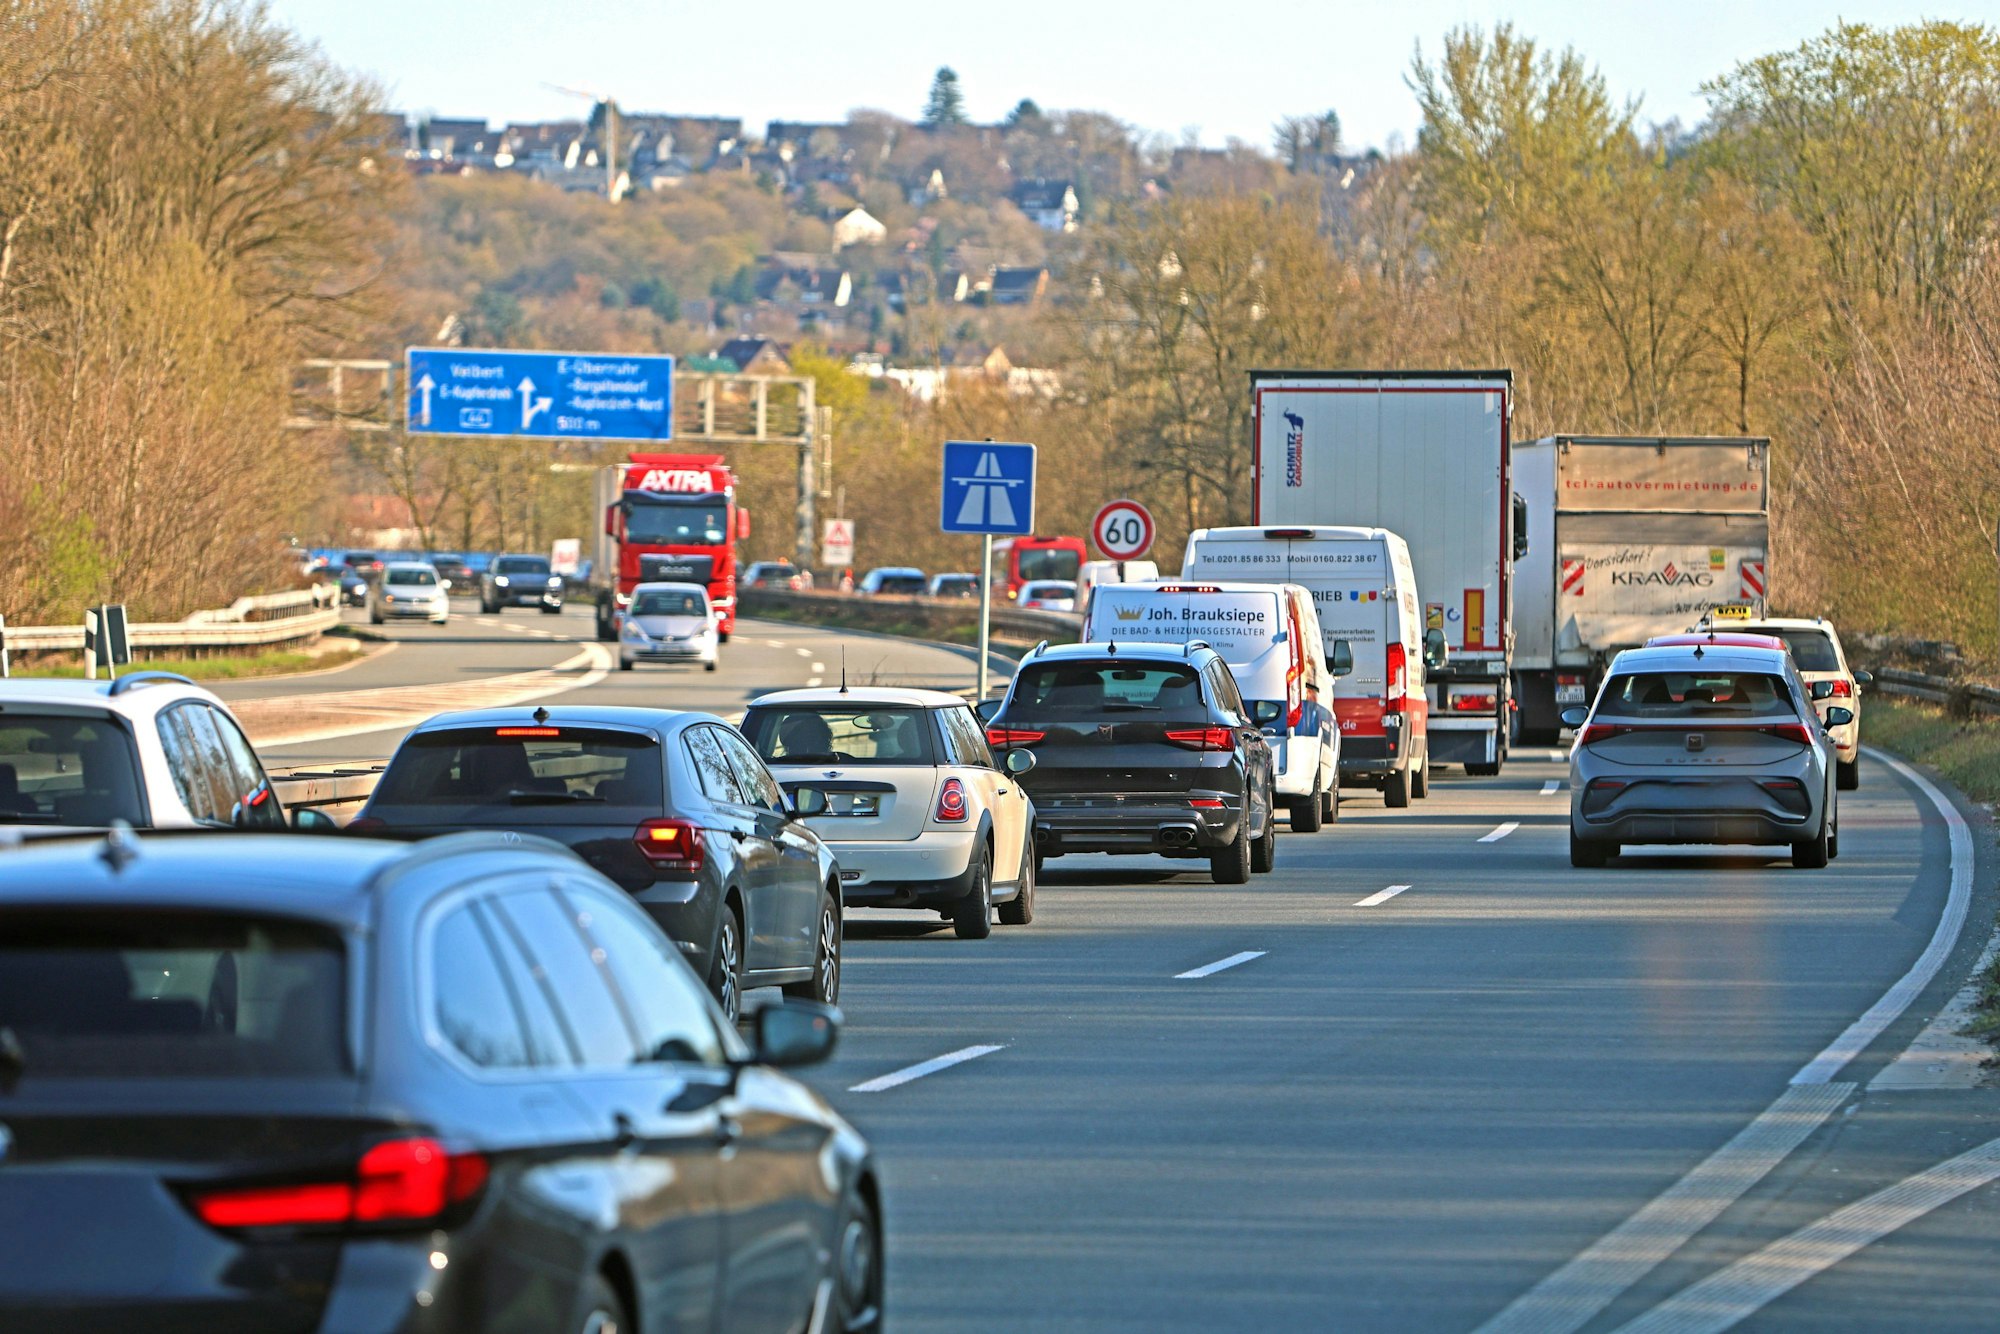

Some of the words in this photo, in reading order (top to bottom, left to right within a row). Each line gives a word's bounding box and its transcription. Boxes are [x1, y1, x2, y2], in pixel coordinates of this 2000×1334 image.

[1287, 432, 1296, 487] SCHMITZ
[639, 470, 713, 491] AXTRA
[1106, 518, 1140, 544] 60
[1253, 555, 1264, 563] 86
[1266, 555, 1281, 563] 333
[1287, 555, 1311, 563] Mobil
[1313, 555, 1353, 563] 0160.822
[1354, 555, 1365, 563] 38
[1367, 555, 1377, 563] 67
[1612, 572, 1714, 586] KRAVAG
[1313, 591, 1342, 601] RIEB
[1147, 608, 1177, 621] Joh.
[1182, 608, 1265, 624] Brauksiepe
[1112, 627, 1127, 636] DIE
[1130, 627, 1151, 636] BAD-
[1155, 627, 1161, 636] &
[1164, 627, 1265, 637] HEIZUNGSGESTALTER
[1340, 719, 1357, 730] .de
